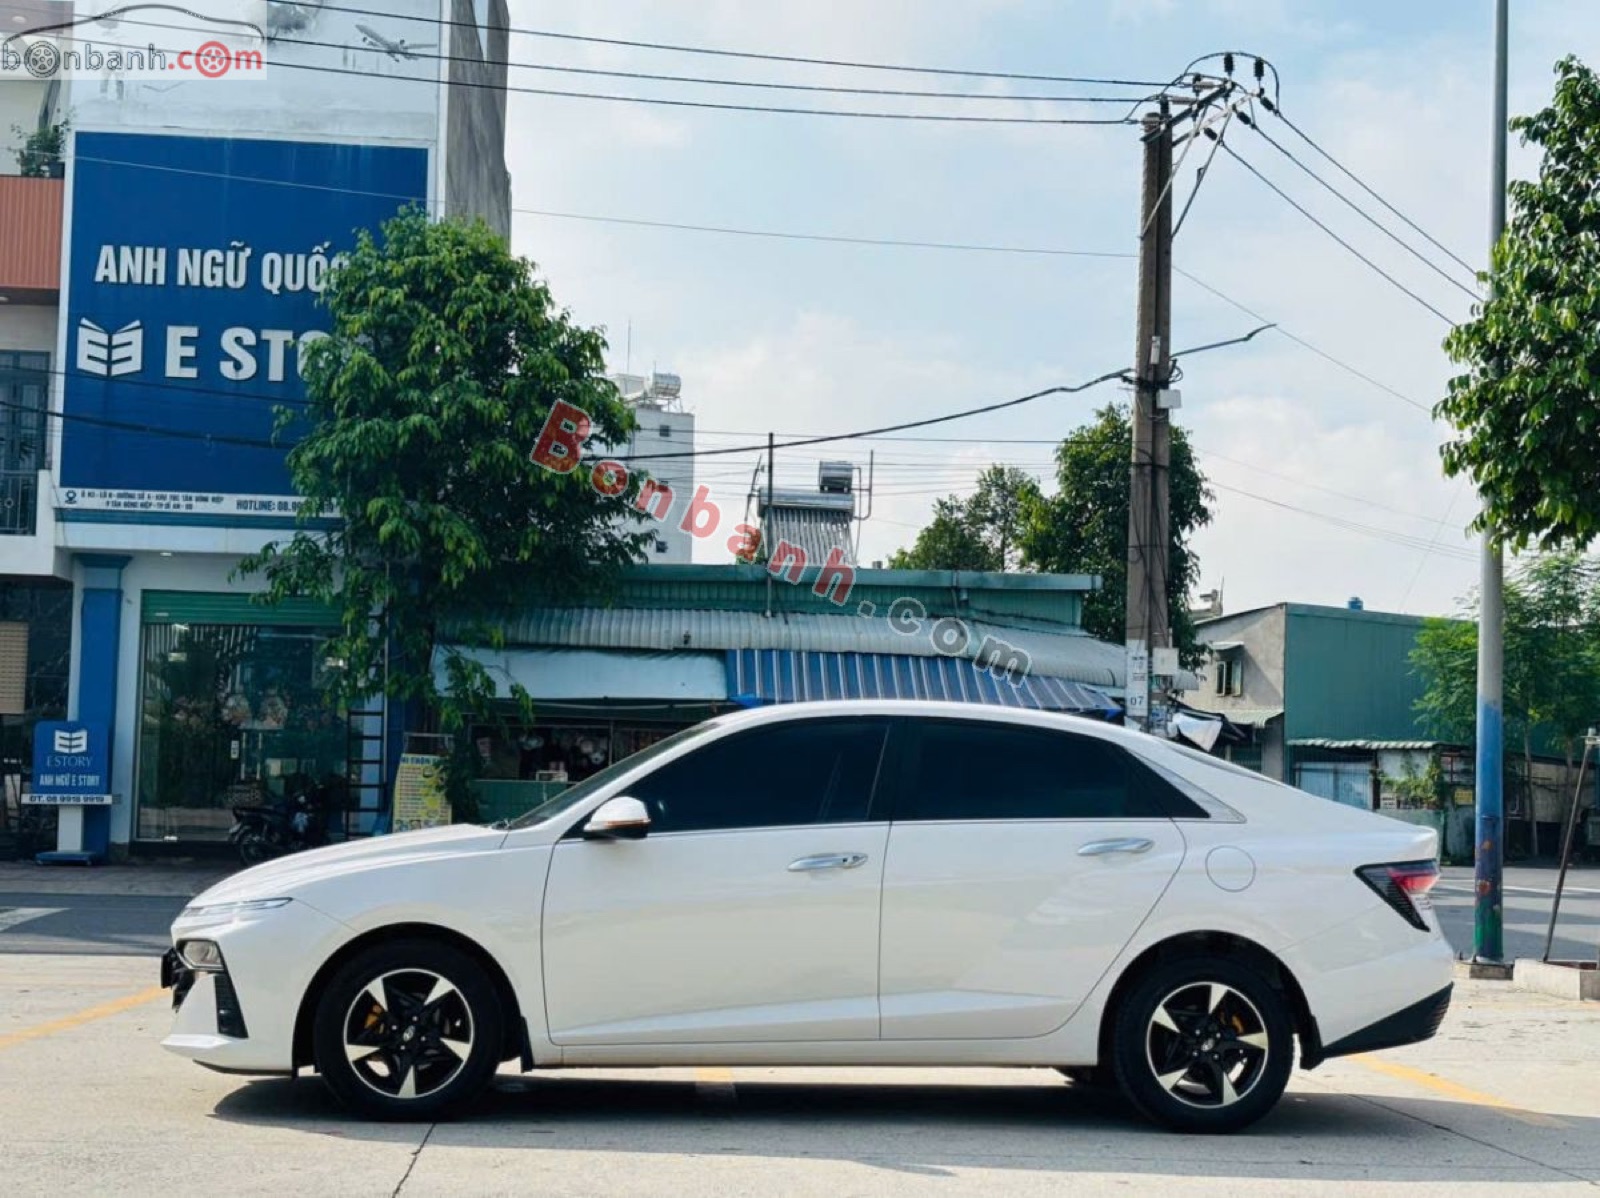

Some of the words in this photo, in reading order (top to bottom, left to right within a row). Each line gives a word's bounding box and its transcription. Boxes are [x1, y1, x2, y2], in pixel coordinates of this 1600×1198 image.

[94, 244, 167, 286] ANH
[176, 240, 252, 289] NGỮ
[165, 325, 199, 378] E
